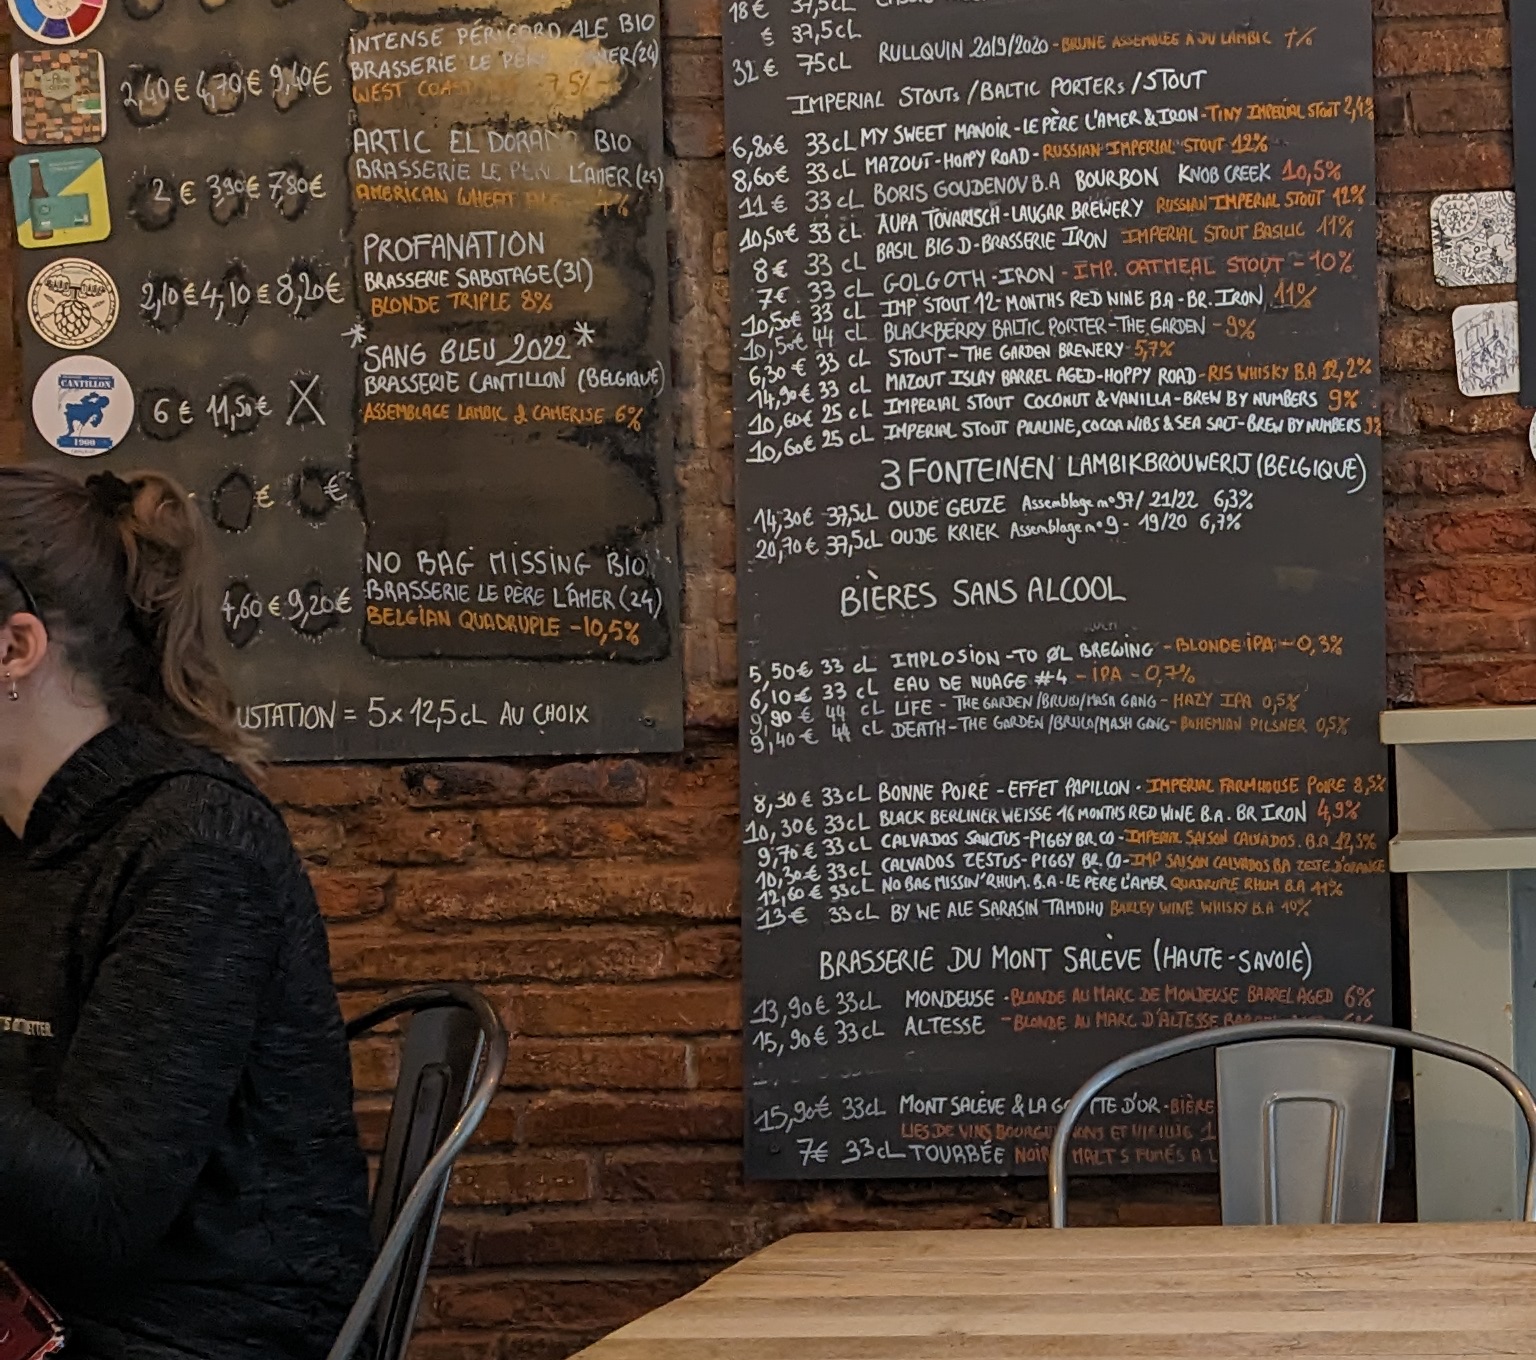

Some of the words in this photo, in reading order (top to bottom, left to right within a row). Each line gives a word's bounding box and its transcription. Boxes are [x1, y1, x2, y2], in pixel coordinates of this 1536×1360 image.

[786, 91, 884, 114] IMPERIAL
[1075, 167, 1159, 191] BOURBON
[1179, 164, 1219, 183] KNOB
[1224, 163, 1271, 183] CREEK
[364, 231, 544, 264] PROFANATION
[365, 270, 449, 291] BRASSERIE
[884, 270, 985, 293] GOLGOTH
[1227, 256, 1284, 277] STOUT
[372, 294, 439, 317] BLONDE
[446, 292, 510, 311] TRIPLE
[364, 343, 426, 372] SANG
[440, 338, 495, 364] BLEU
[496, 334, 571, 366] 2022
[60, 379, 112, 389] CANTILLON
[364, 367, 459, 396] BRASSERIE
[469, 367, 565, 393] CANTILLON
[578, 361, 665, 396] (BELGIQUE)
[881, 460, 901, 490] 3
[909, 455, 1054, 486] FONTEINEN
[1068, 452, 1252, 476] LAMBIKBROUWERIJ
[1257, 453, 1366, 493] (BELGIQUE)
[946, 495, 1006, 517] GEUZE
[367, 552, 400, 573] NO
[417, 546, 474, 576] BAG
[841, 570, 937, 616] BIÈRES
[953, 579, 1017, 606] SANS
[1028, 576, 1126, 602] ALCOOL
[367, 605, 451, 626] BELGIAN
[233, 700, 336, 729] USTATION
[500, 701, 524, 725] AU
[533, 704, 589, 725] CHOIX
[879, 782, 933, 802] BONNE
[942, 782, 989, 800] POIRE
[1008, 780, 1058, 798] EFFET
[1065, 777, 1129, 797] PAPILLON
[820, 946, 933, 979] BRASSERIE
[947, 947, 981, 972] DU
[992, 945, 1052, 970] MONT
[1064, 934, 1141, 972] SALÈVE
[906, 990, 994, 1008] MONDEUSE
[905, 1016, 985, 1036] ALTESSE
[908, 1134, 1005, 1164] TOURBÉE
